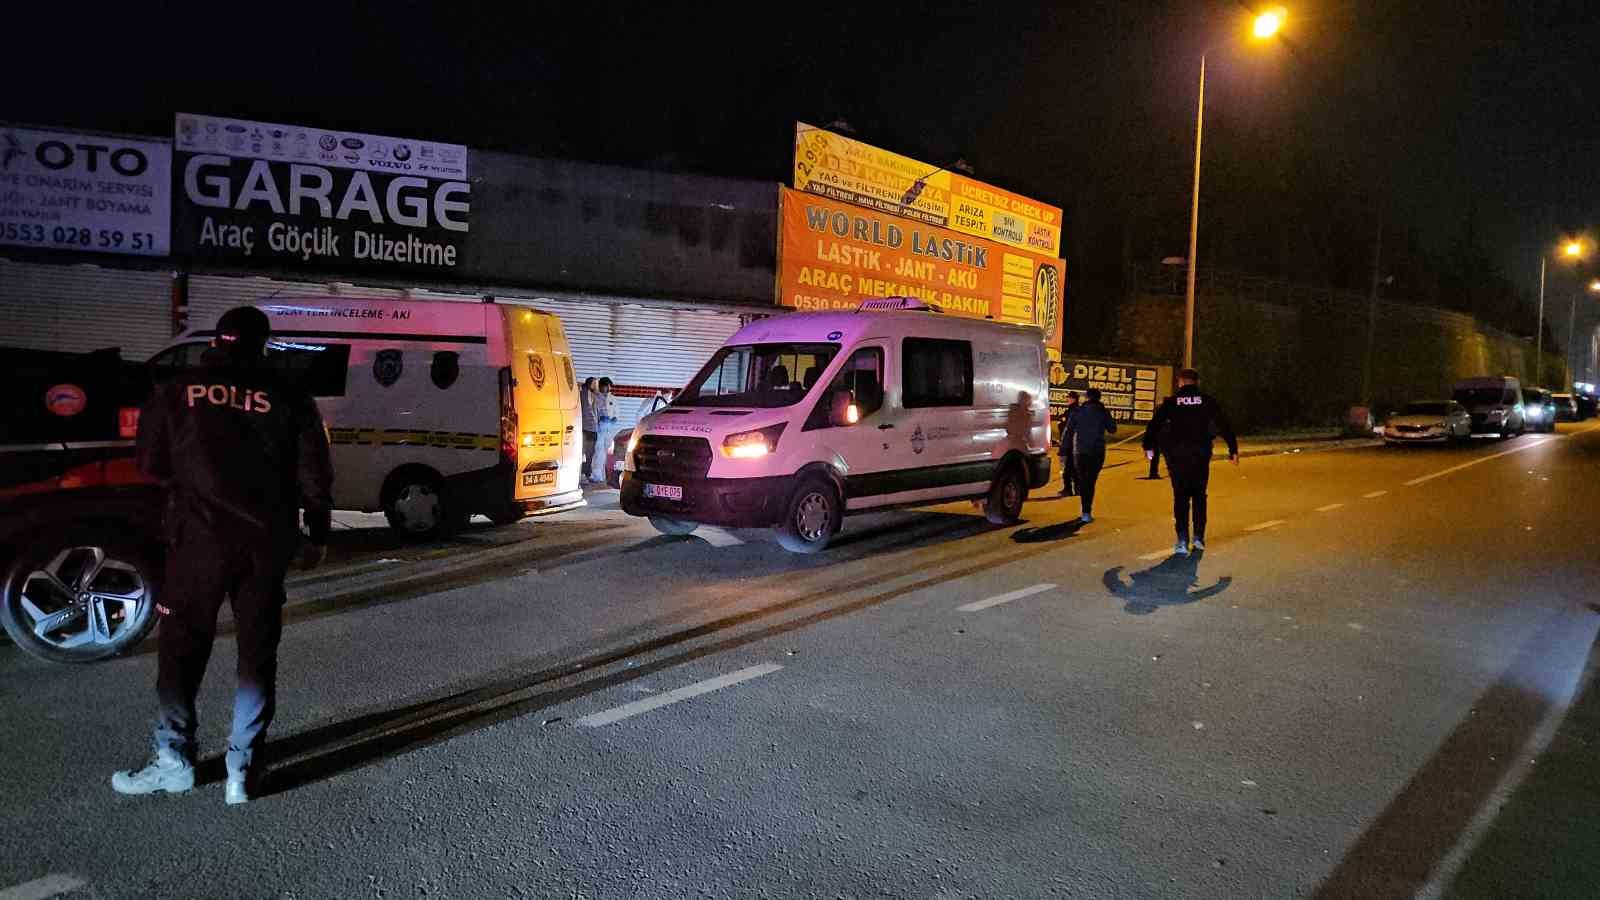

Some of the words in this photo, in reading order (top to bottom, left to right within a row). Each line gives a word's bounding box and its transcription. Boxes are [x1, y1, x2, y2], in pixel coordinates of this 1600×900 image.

[35, 140, 148, 176] OTO
[368, 159, 411, 170] VOLVO
[184, 154, 470, 232] GARAGE
[53, 226, 91, 246] 028
[98, 230, 124, 248] 59
[131, 232, 153, 250] 51
[199, 216, 255, 255] Araç
[267, 221, 340, 261] Göçük
[353, 230, 457, 266] Düzeltme
[804, 206, 903, 249] WORLD
[798, 265, 853, 297] ARAÇ
[894, 256, 935, 282] JANT
[947, 266, 979, 291] AKÜ
[1088, 380, 1126, 392] WORLD
